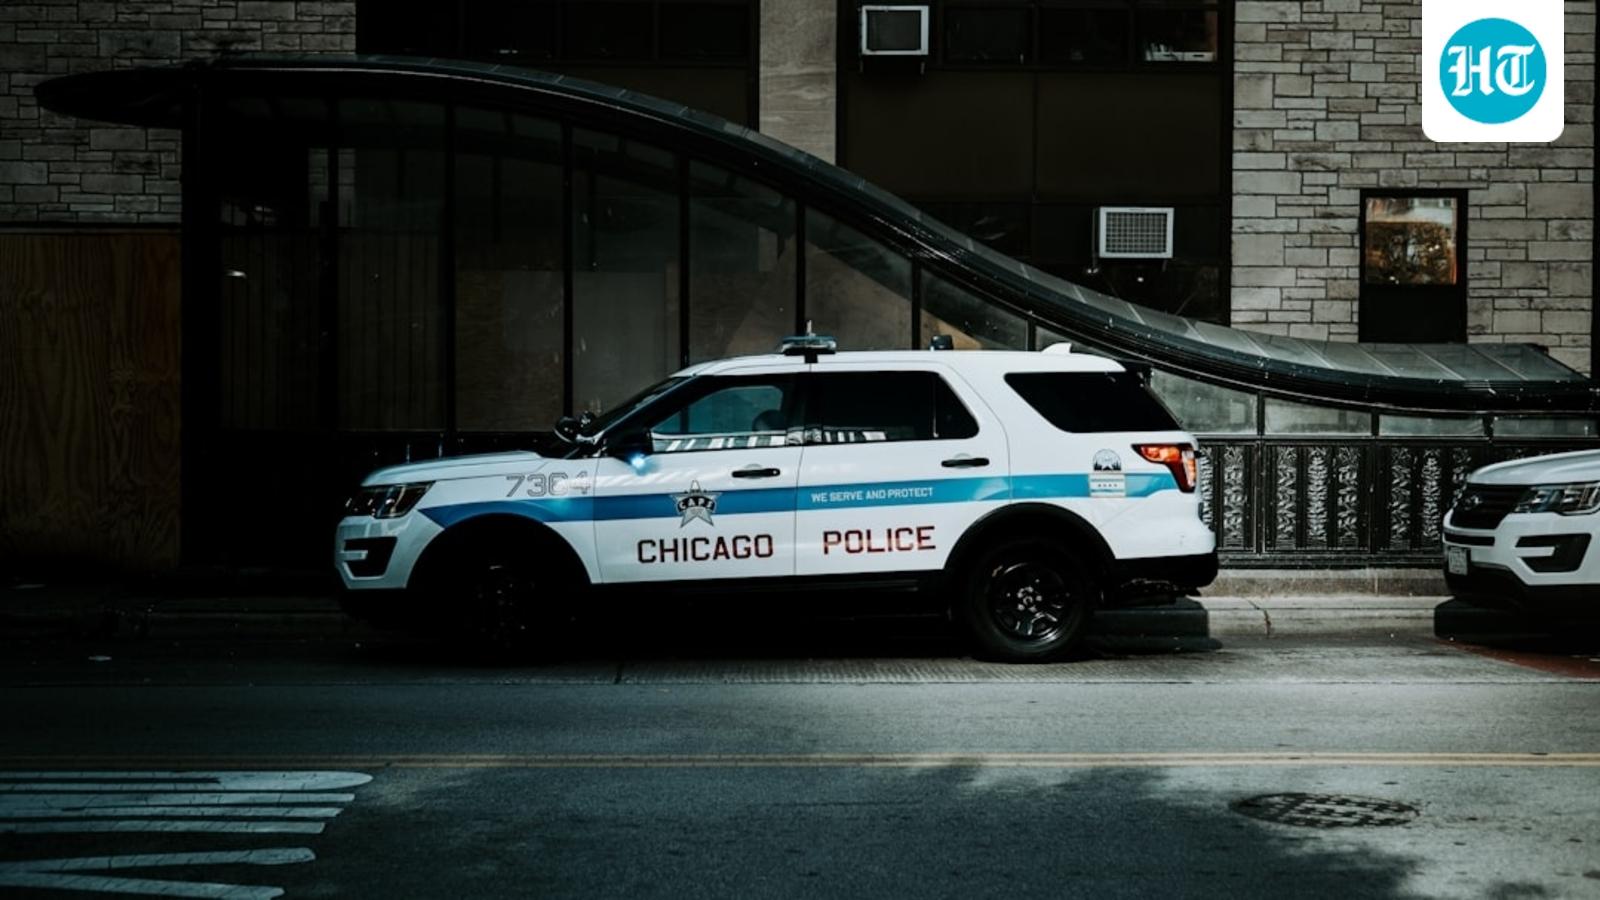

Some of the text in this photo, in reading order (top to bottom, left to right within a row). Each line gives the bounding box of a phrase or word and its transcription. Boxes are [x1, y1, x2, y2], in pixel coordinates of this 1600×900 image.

[811, 486, 933, 503] WE SERVE AND PROTECT
[637, 525, 936, 564] CHICAGO POLICE
